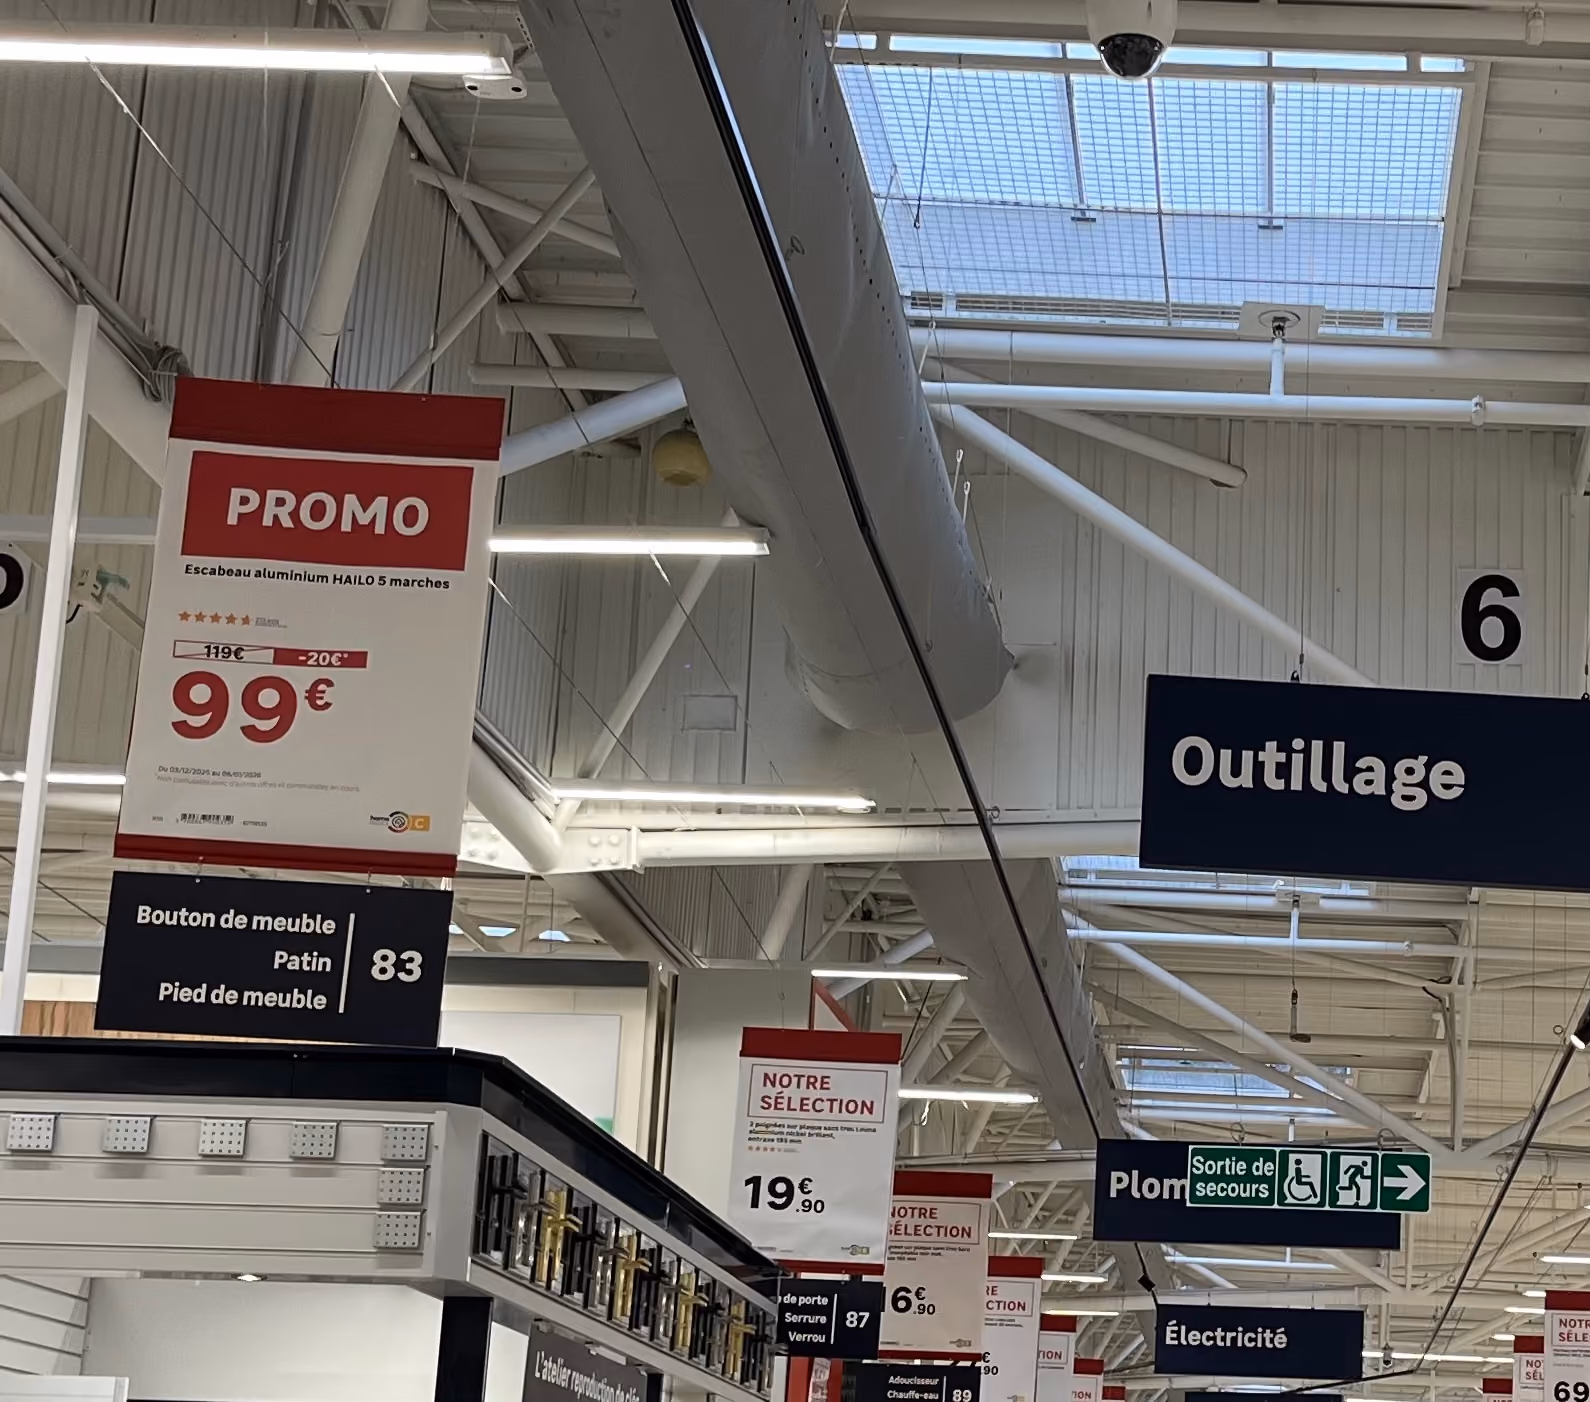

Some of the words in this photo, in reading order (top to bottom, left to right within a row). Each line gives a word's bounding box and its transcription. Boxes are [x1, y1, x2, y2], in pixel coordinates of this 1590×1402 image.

[226, 487, 430, 536] PROMO
[184, 563, 251, 578] Escabeau
[254, 569, 329, 584] aluminium
[333, 573, 375, 586] HAILO
[378, 575, 387, 586] 5
[389, 576, 450, 589] marches
[1461, 575, 1521, 661] 6
[203, 644, 246, 661] 119€
[1172, 736, 1466, 811] Outillage
[137, 905, 216, 928] Bouton
[220, 909, 247, 929] de
[252, 913, 336, 935] meuble
[273, 950, 332, 972] Patin
[370, 949, 423, 982] 83
[158, 981, 207, 1004] Pied
[210, 984, 238, 1005] de
[242, 988, 327, 1010] meuble
[763, 1072, 831, 1090] NOTRE
[760, 1090, 875, 1115] SÉLECTION
[1192, 1156, 1250, 1175] Sortie
[1252, 1157, 1274, 1176] de
[1195, 1181, 1270, 1198] secours
[784, 1294, 797, 1305] de
[798, 1295, 828, 1306] porte
[785, 1312, 827, 1324] Serrure
[845, 1311, 870, 1328] 87
[788, 1331, 826, 1342] Verrou
[1165, 1320, 1288, 1349] Électricité
[534, 1350, 571, 1389] L'atelier
[888, 1375, 940, 1386] Adoucisseur
[887, 1389, 939, 1401] Chauffe-eau
[952, 1389, 972, 1402] 89
